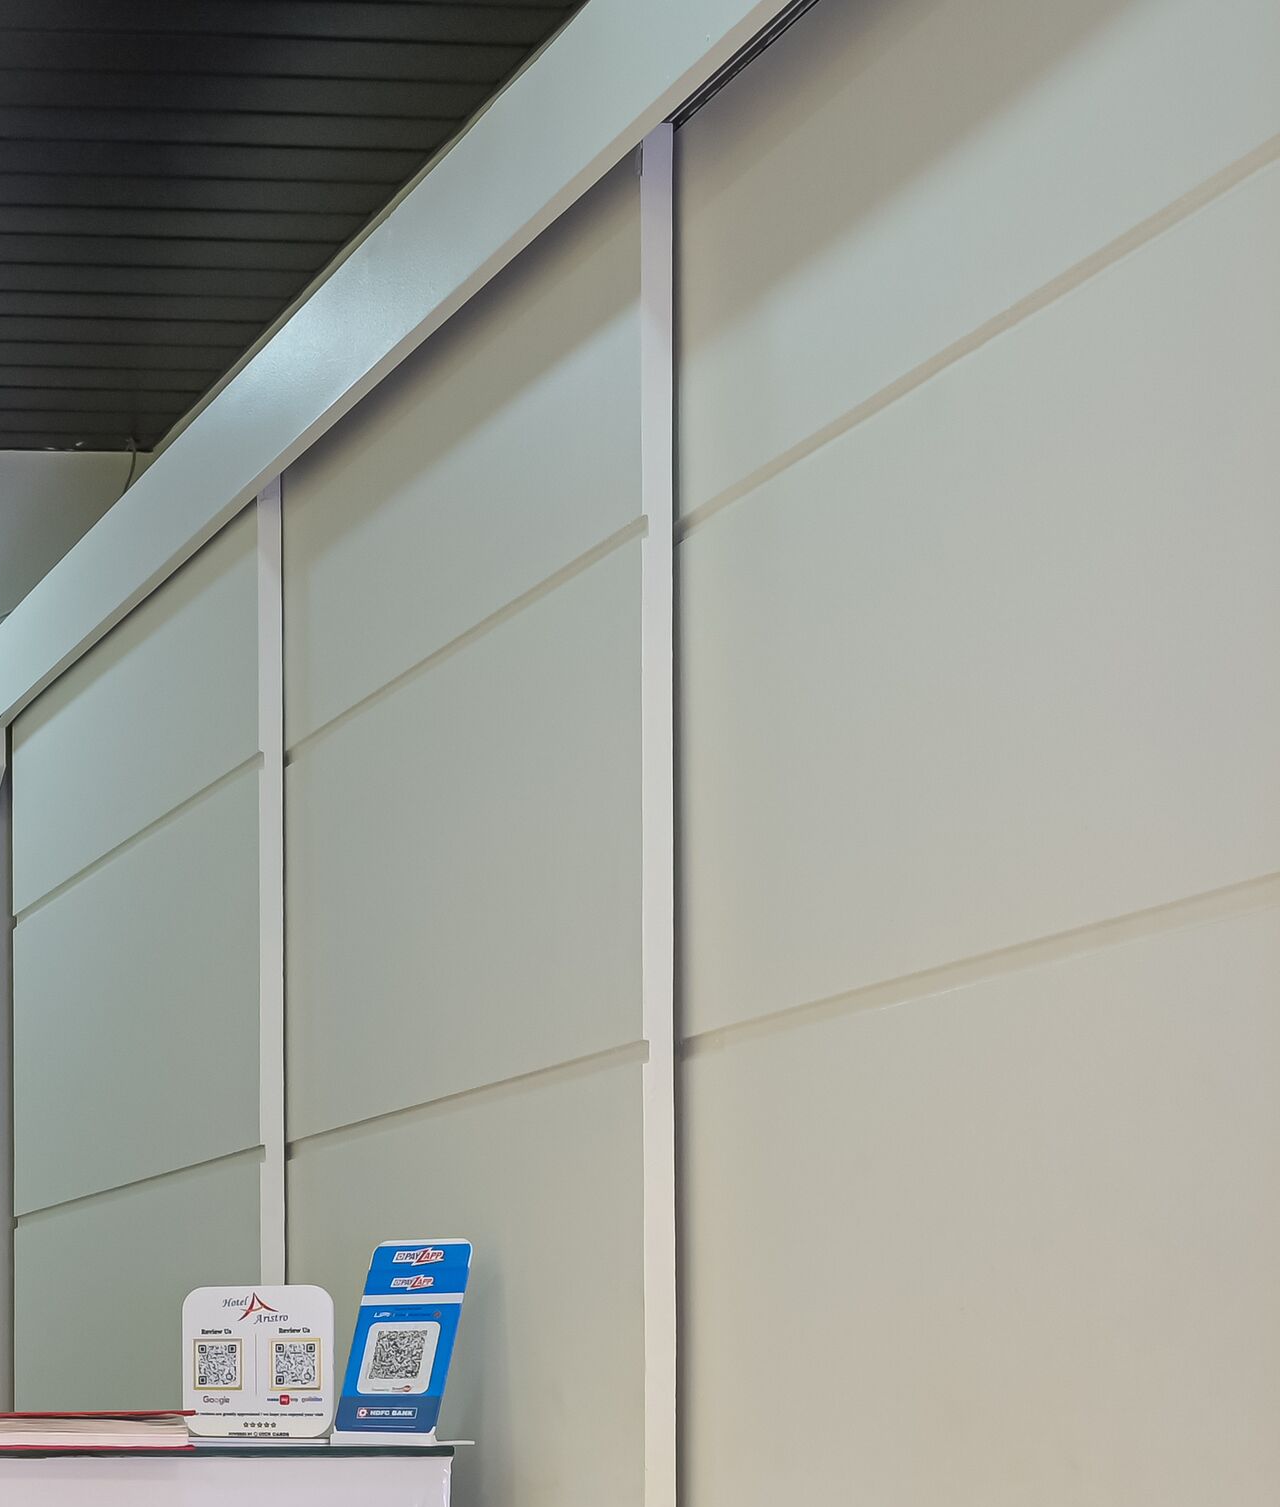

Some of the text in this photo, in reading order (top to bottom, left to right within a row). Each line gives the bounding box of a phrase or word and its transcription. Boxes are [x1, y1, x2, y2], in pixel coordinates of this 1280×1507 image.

[222, 1296, 249, 1308] Hotel
[253, 1314, 289, 1325] Aristro
[202, 1395, 231, 1407] Google
